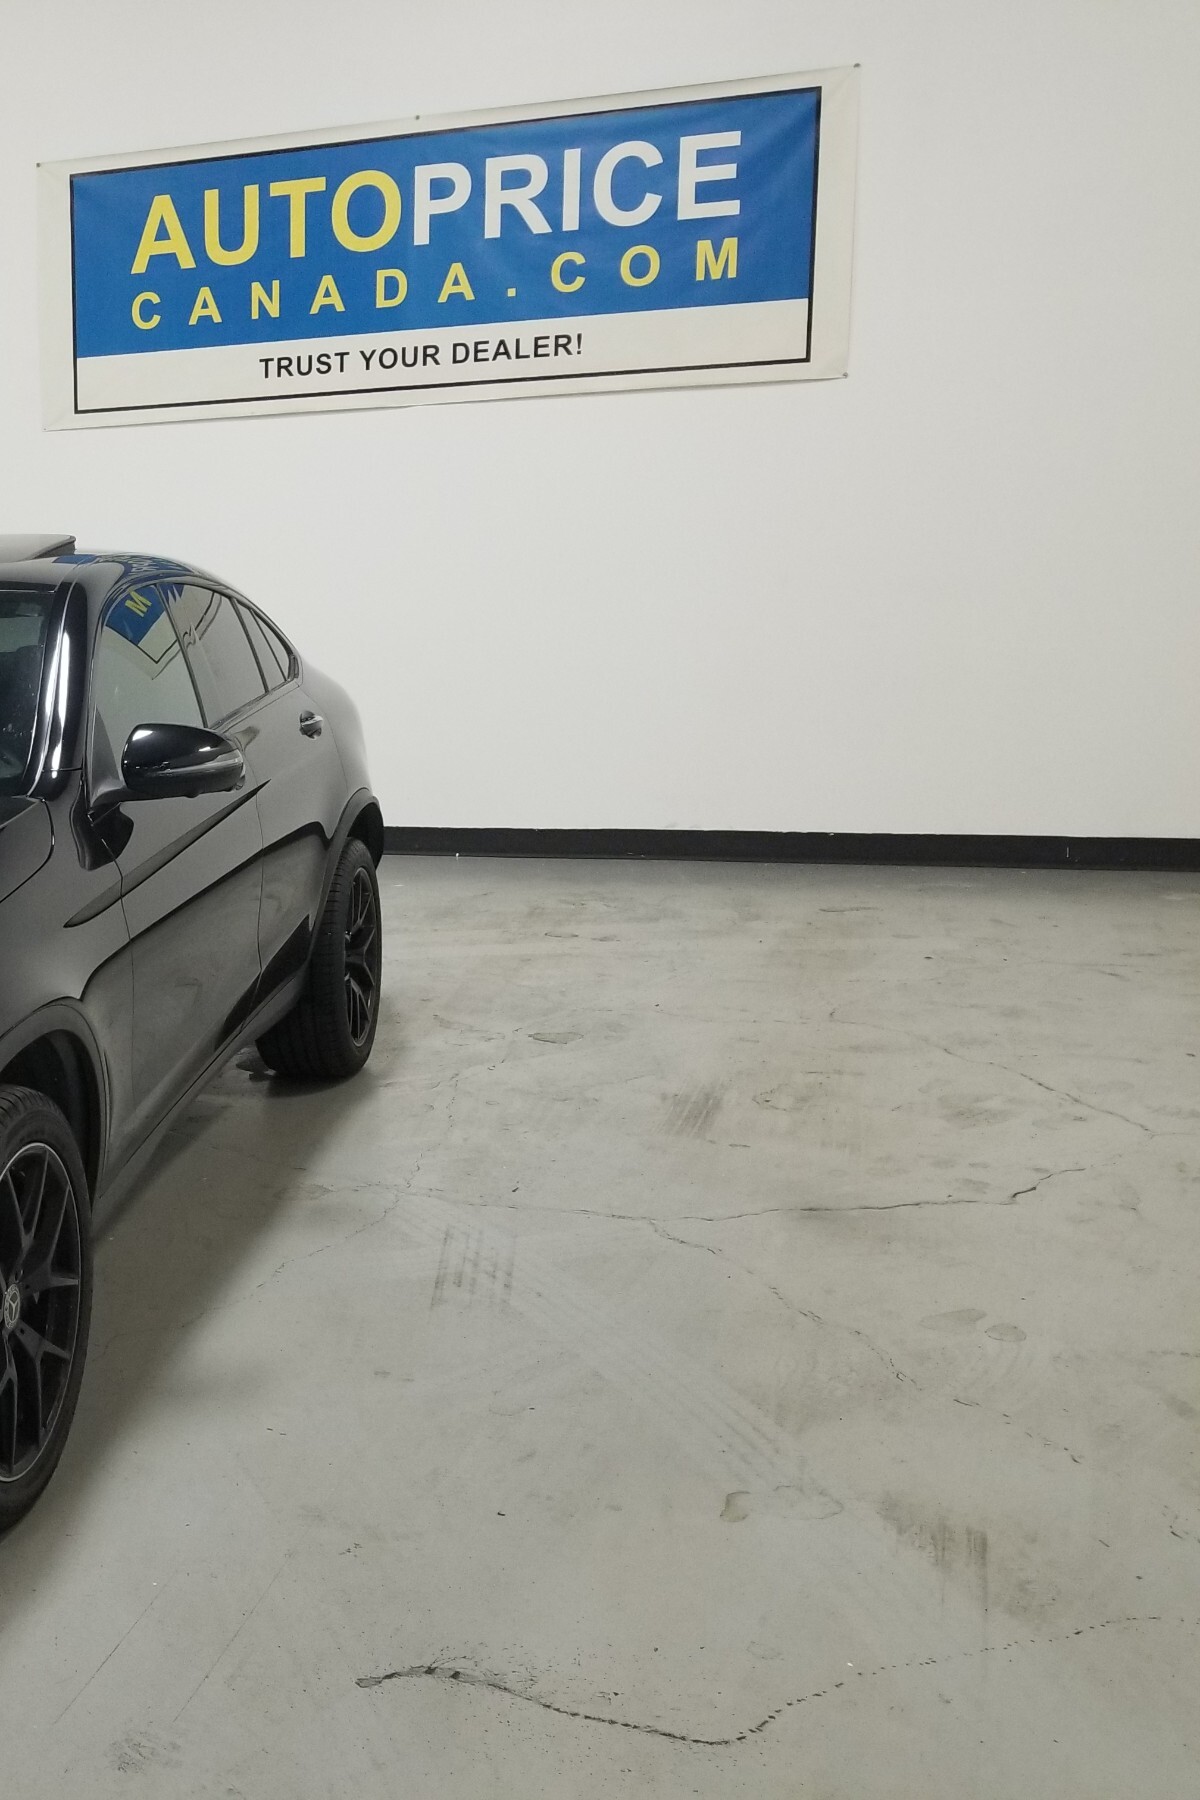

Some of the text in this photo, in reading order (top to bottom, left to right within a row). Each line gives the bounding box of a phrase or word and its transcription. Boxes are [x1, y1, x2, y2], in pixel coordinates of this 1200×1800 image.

[130, 130, 742, 275] AUTOPRICE
[131, 236, 739, 330] CANADA.COM
[259, 332, 583, 379] TRUST YOUR DEALER!
